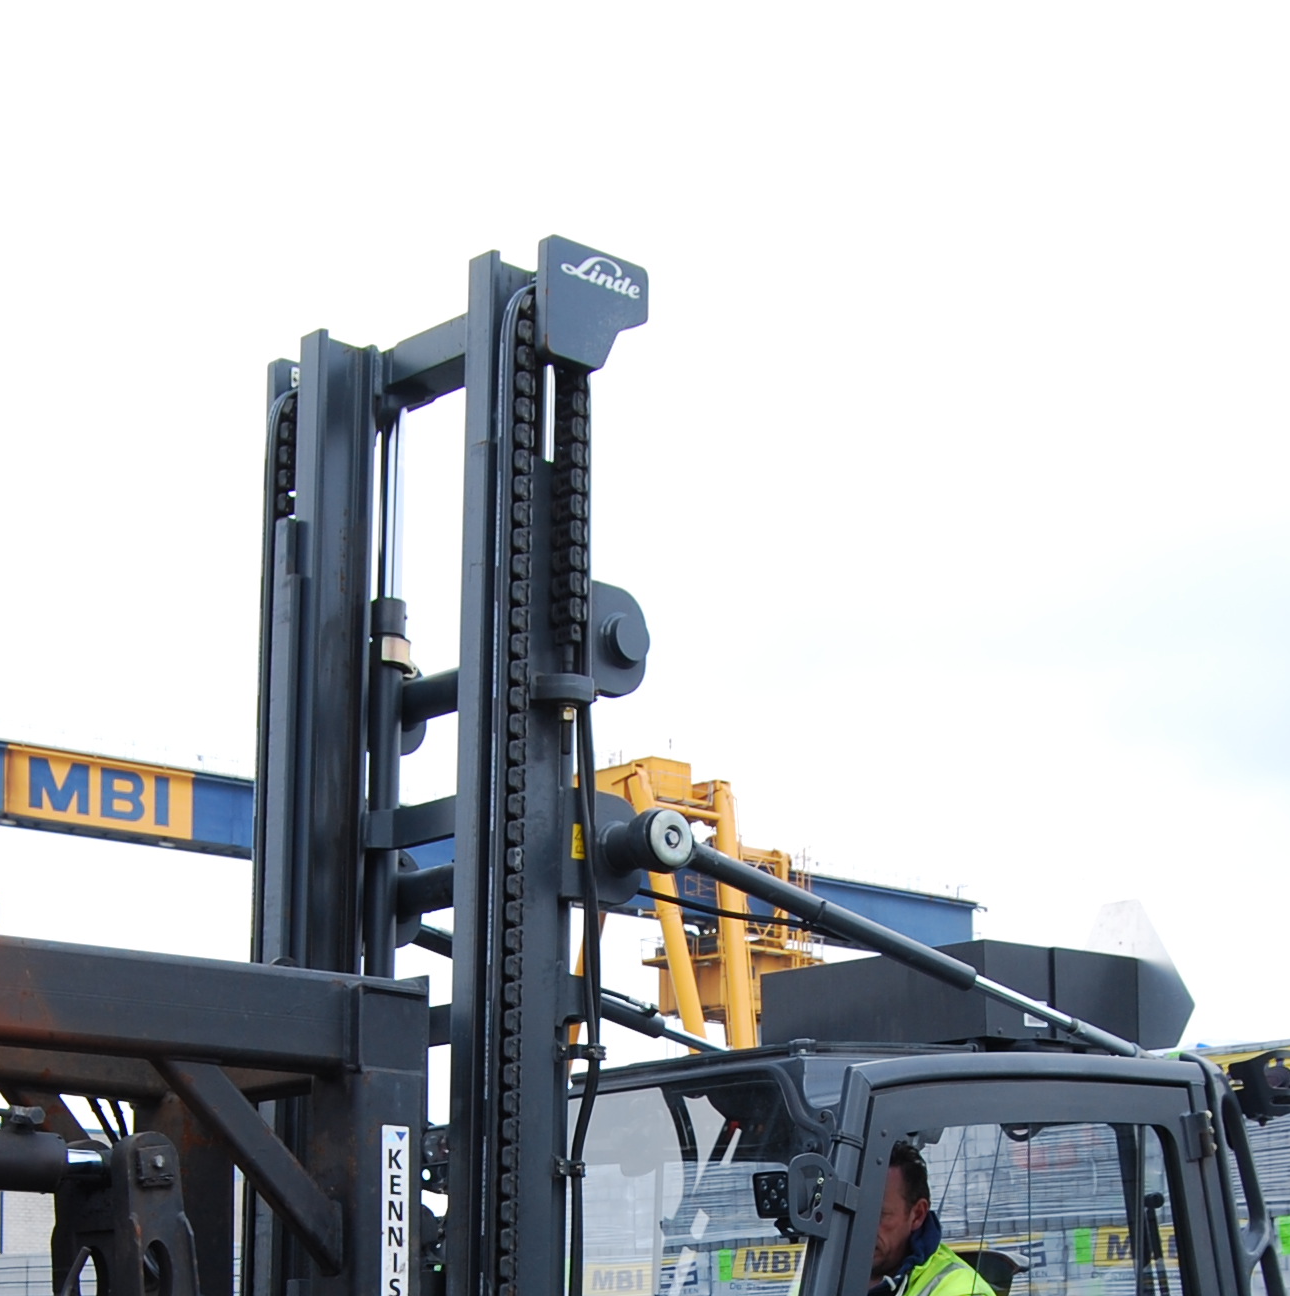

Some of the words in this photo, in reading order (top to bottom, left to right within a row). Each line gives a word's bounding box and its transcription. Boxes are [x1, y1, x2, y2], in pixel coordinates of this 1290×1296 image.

[560, 256, 641, 299] Linde
[28, 756, 170, 827] MBI
[592, 1269, 643, 1291] MBI
